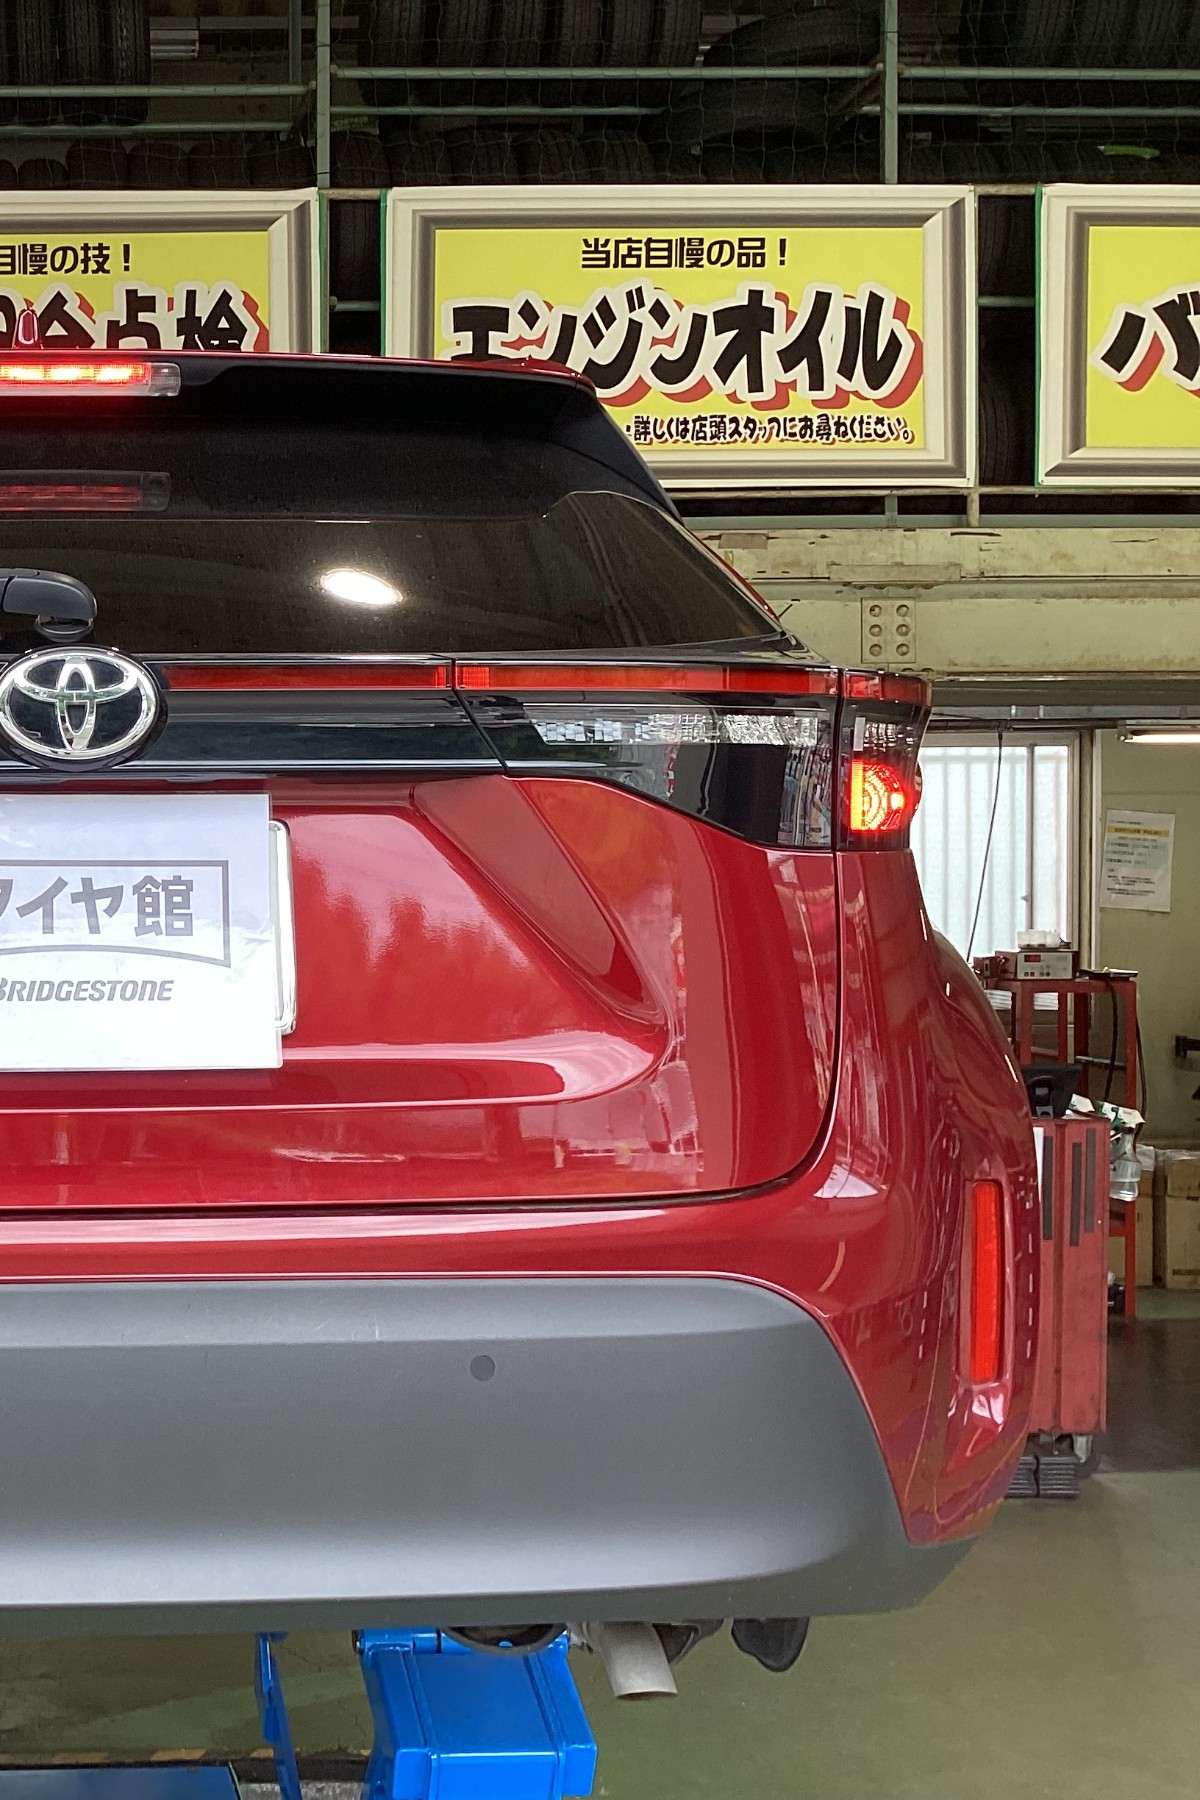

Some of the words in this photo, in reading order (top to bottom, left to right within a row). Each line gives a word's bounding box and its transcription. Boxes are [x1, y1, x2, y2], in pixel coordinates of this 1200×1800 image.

[581, 237, 788, 269] 当店自慢の品！
[452, 286, 904, 394] エンジンオイル
